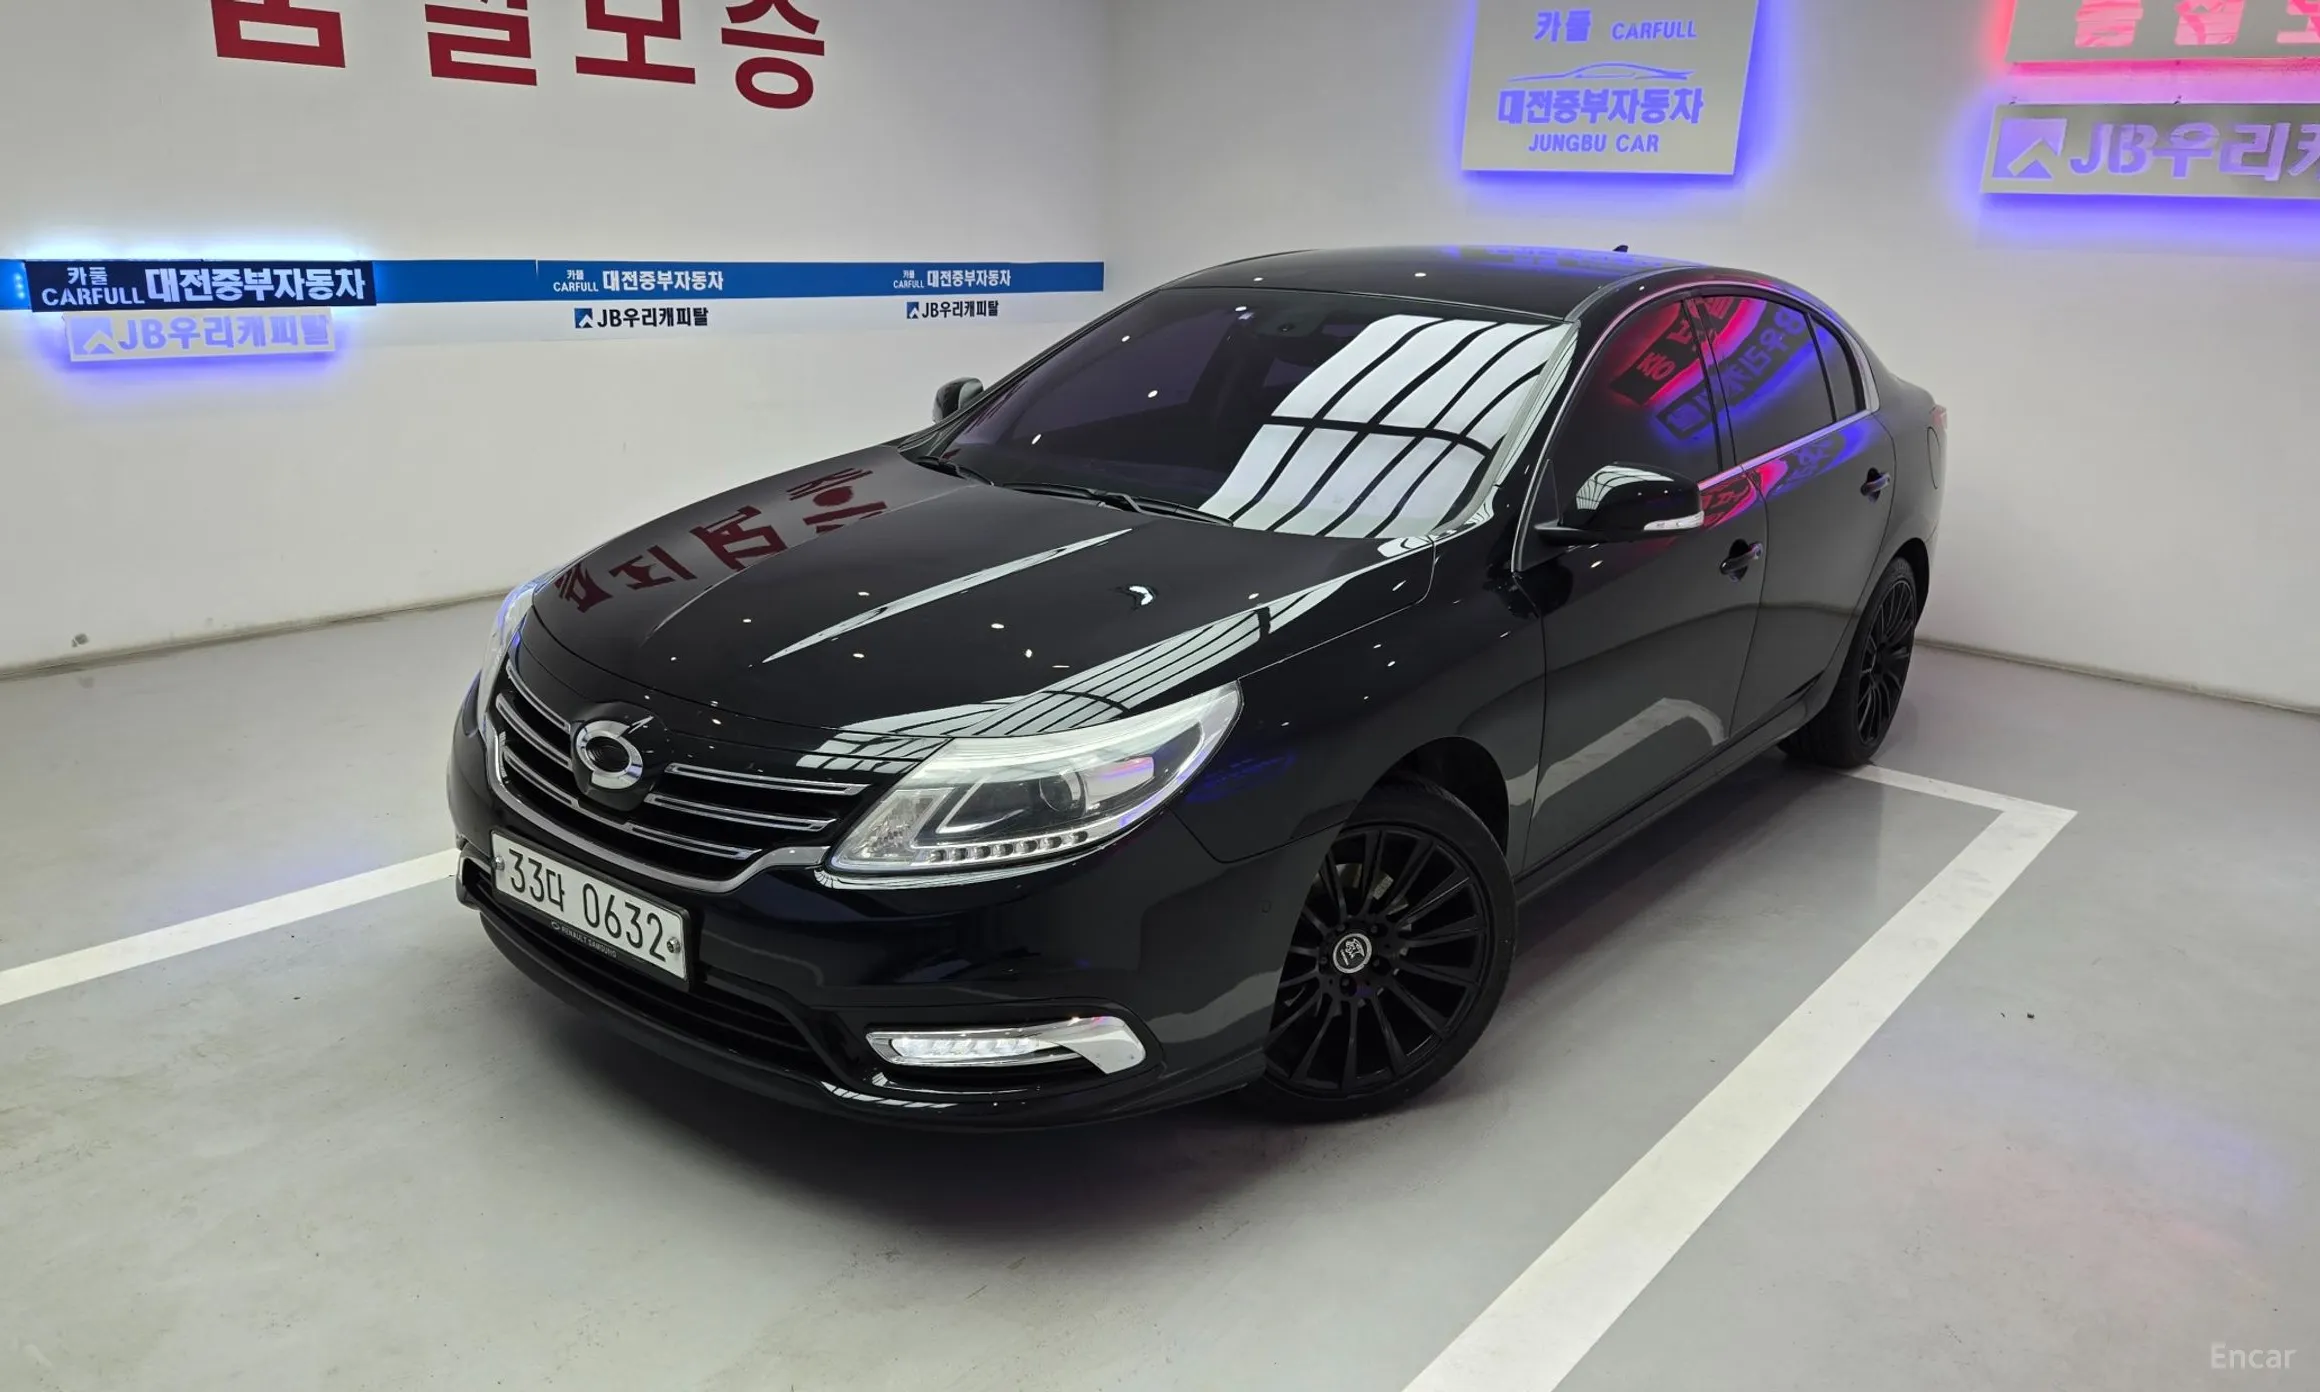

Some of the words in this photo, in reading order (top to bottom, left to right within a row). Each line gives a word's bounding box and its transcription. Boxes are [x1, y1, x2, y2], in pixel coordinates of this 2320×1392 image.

[1611, 20, 1697, 41] CARFULL
[1498, 88, 1704, 124] 대전중부자동차
[1529, 133, 1607, 152] JUNGBU
[1615, 134, 1659, 152] CAR
[145, 268, 366, 302] 대전중부자동차
[553, 282, 599, 292] CARFULL
[602, 270, 724, 291] 대전중부자동차
[893, 280, 924, 288] CARFULL
[927, 270, 1011, 287] 대전중부자동차
[42, 287, 145, 305] CARFULL
[597, 308, 709, 327] JB우리캐피탈
[922, 301, 999, 318] JB우리캐피탈
[119, 315, 330, 350] JB우리캐피탈
[509, 848, 565, 912] 33다
[583, 882, 666, 962] 0632
